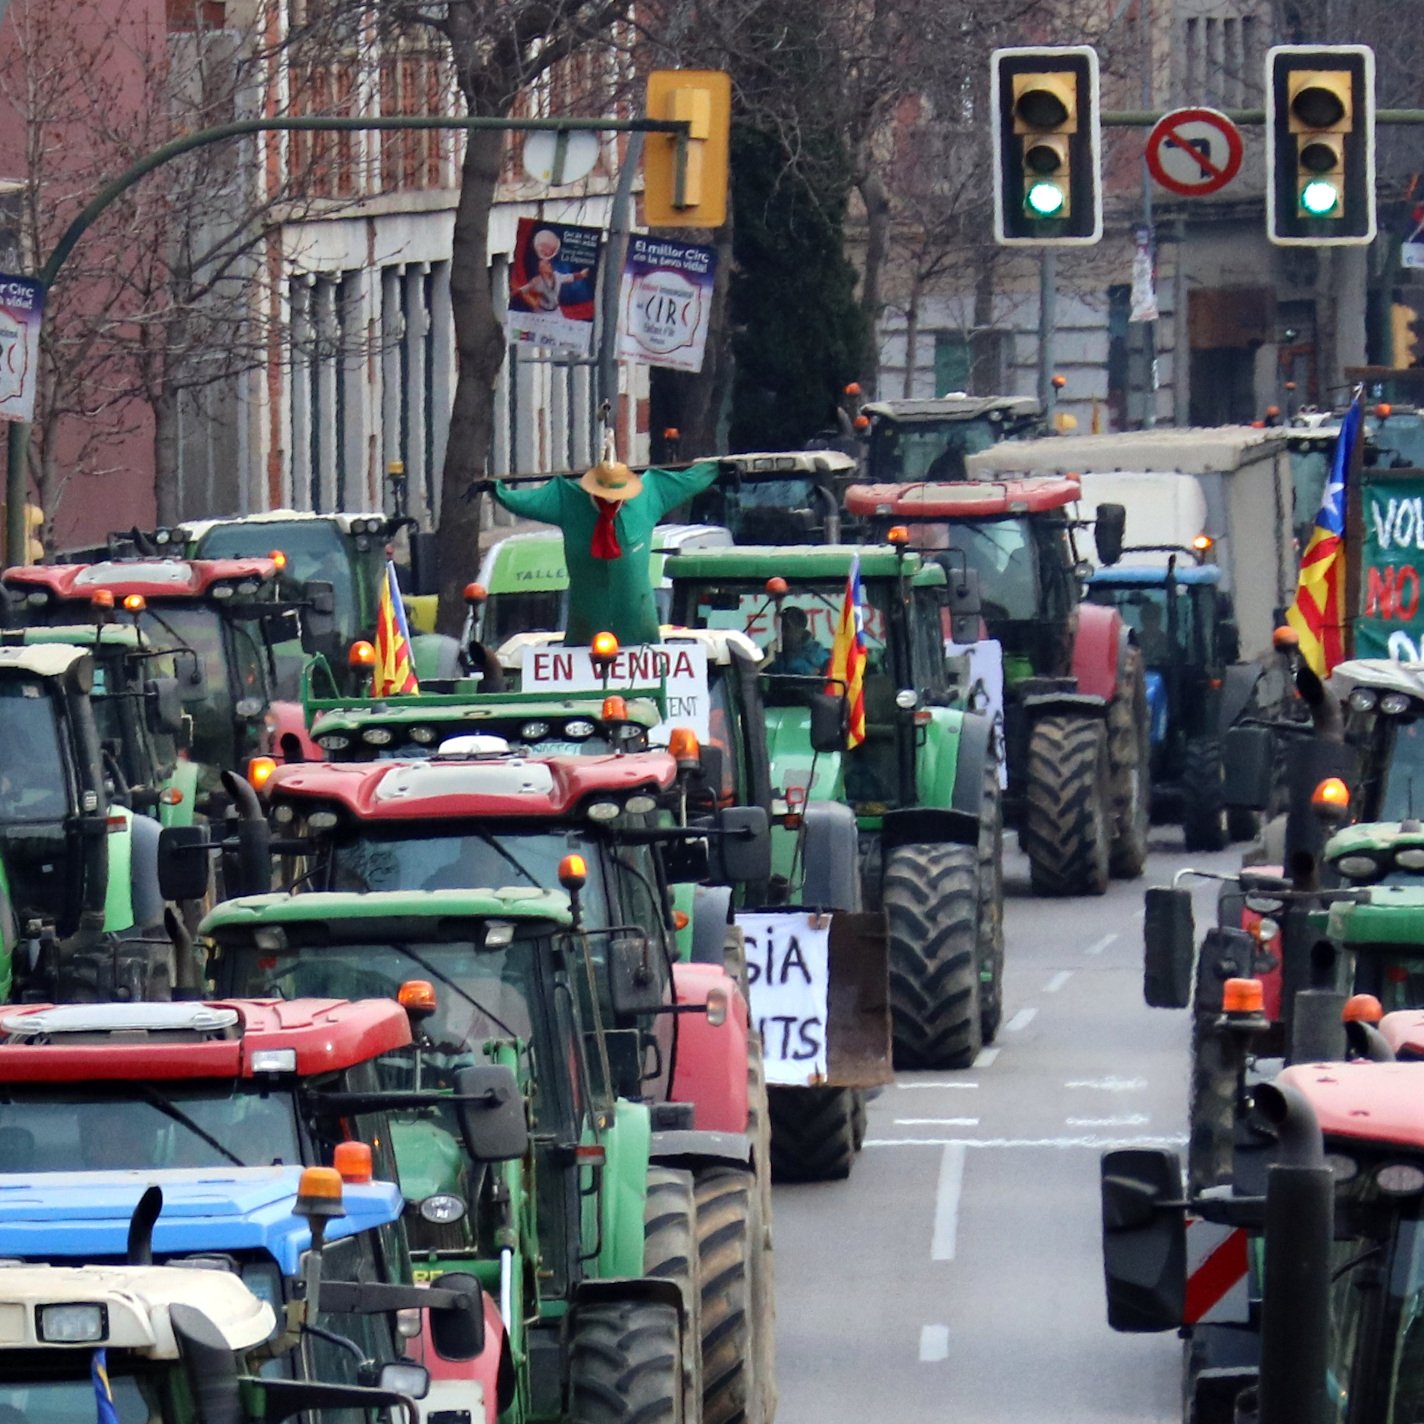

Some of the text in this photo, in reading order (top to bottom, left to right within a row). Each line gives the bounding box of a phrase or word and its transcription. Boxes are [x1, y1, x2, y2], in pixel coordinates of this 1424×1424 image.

[635, 241, 709, 263] El millor Circ
[9, 283, 34, 298] Circ
[646, 295, 691, 327] CIRC
[1365, 564, 1420, 622] NO
[534, 653, 573, 682] EN
